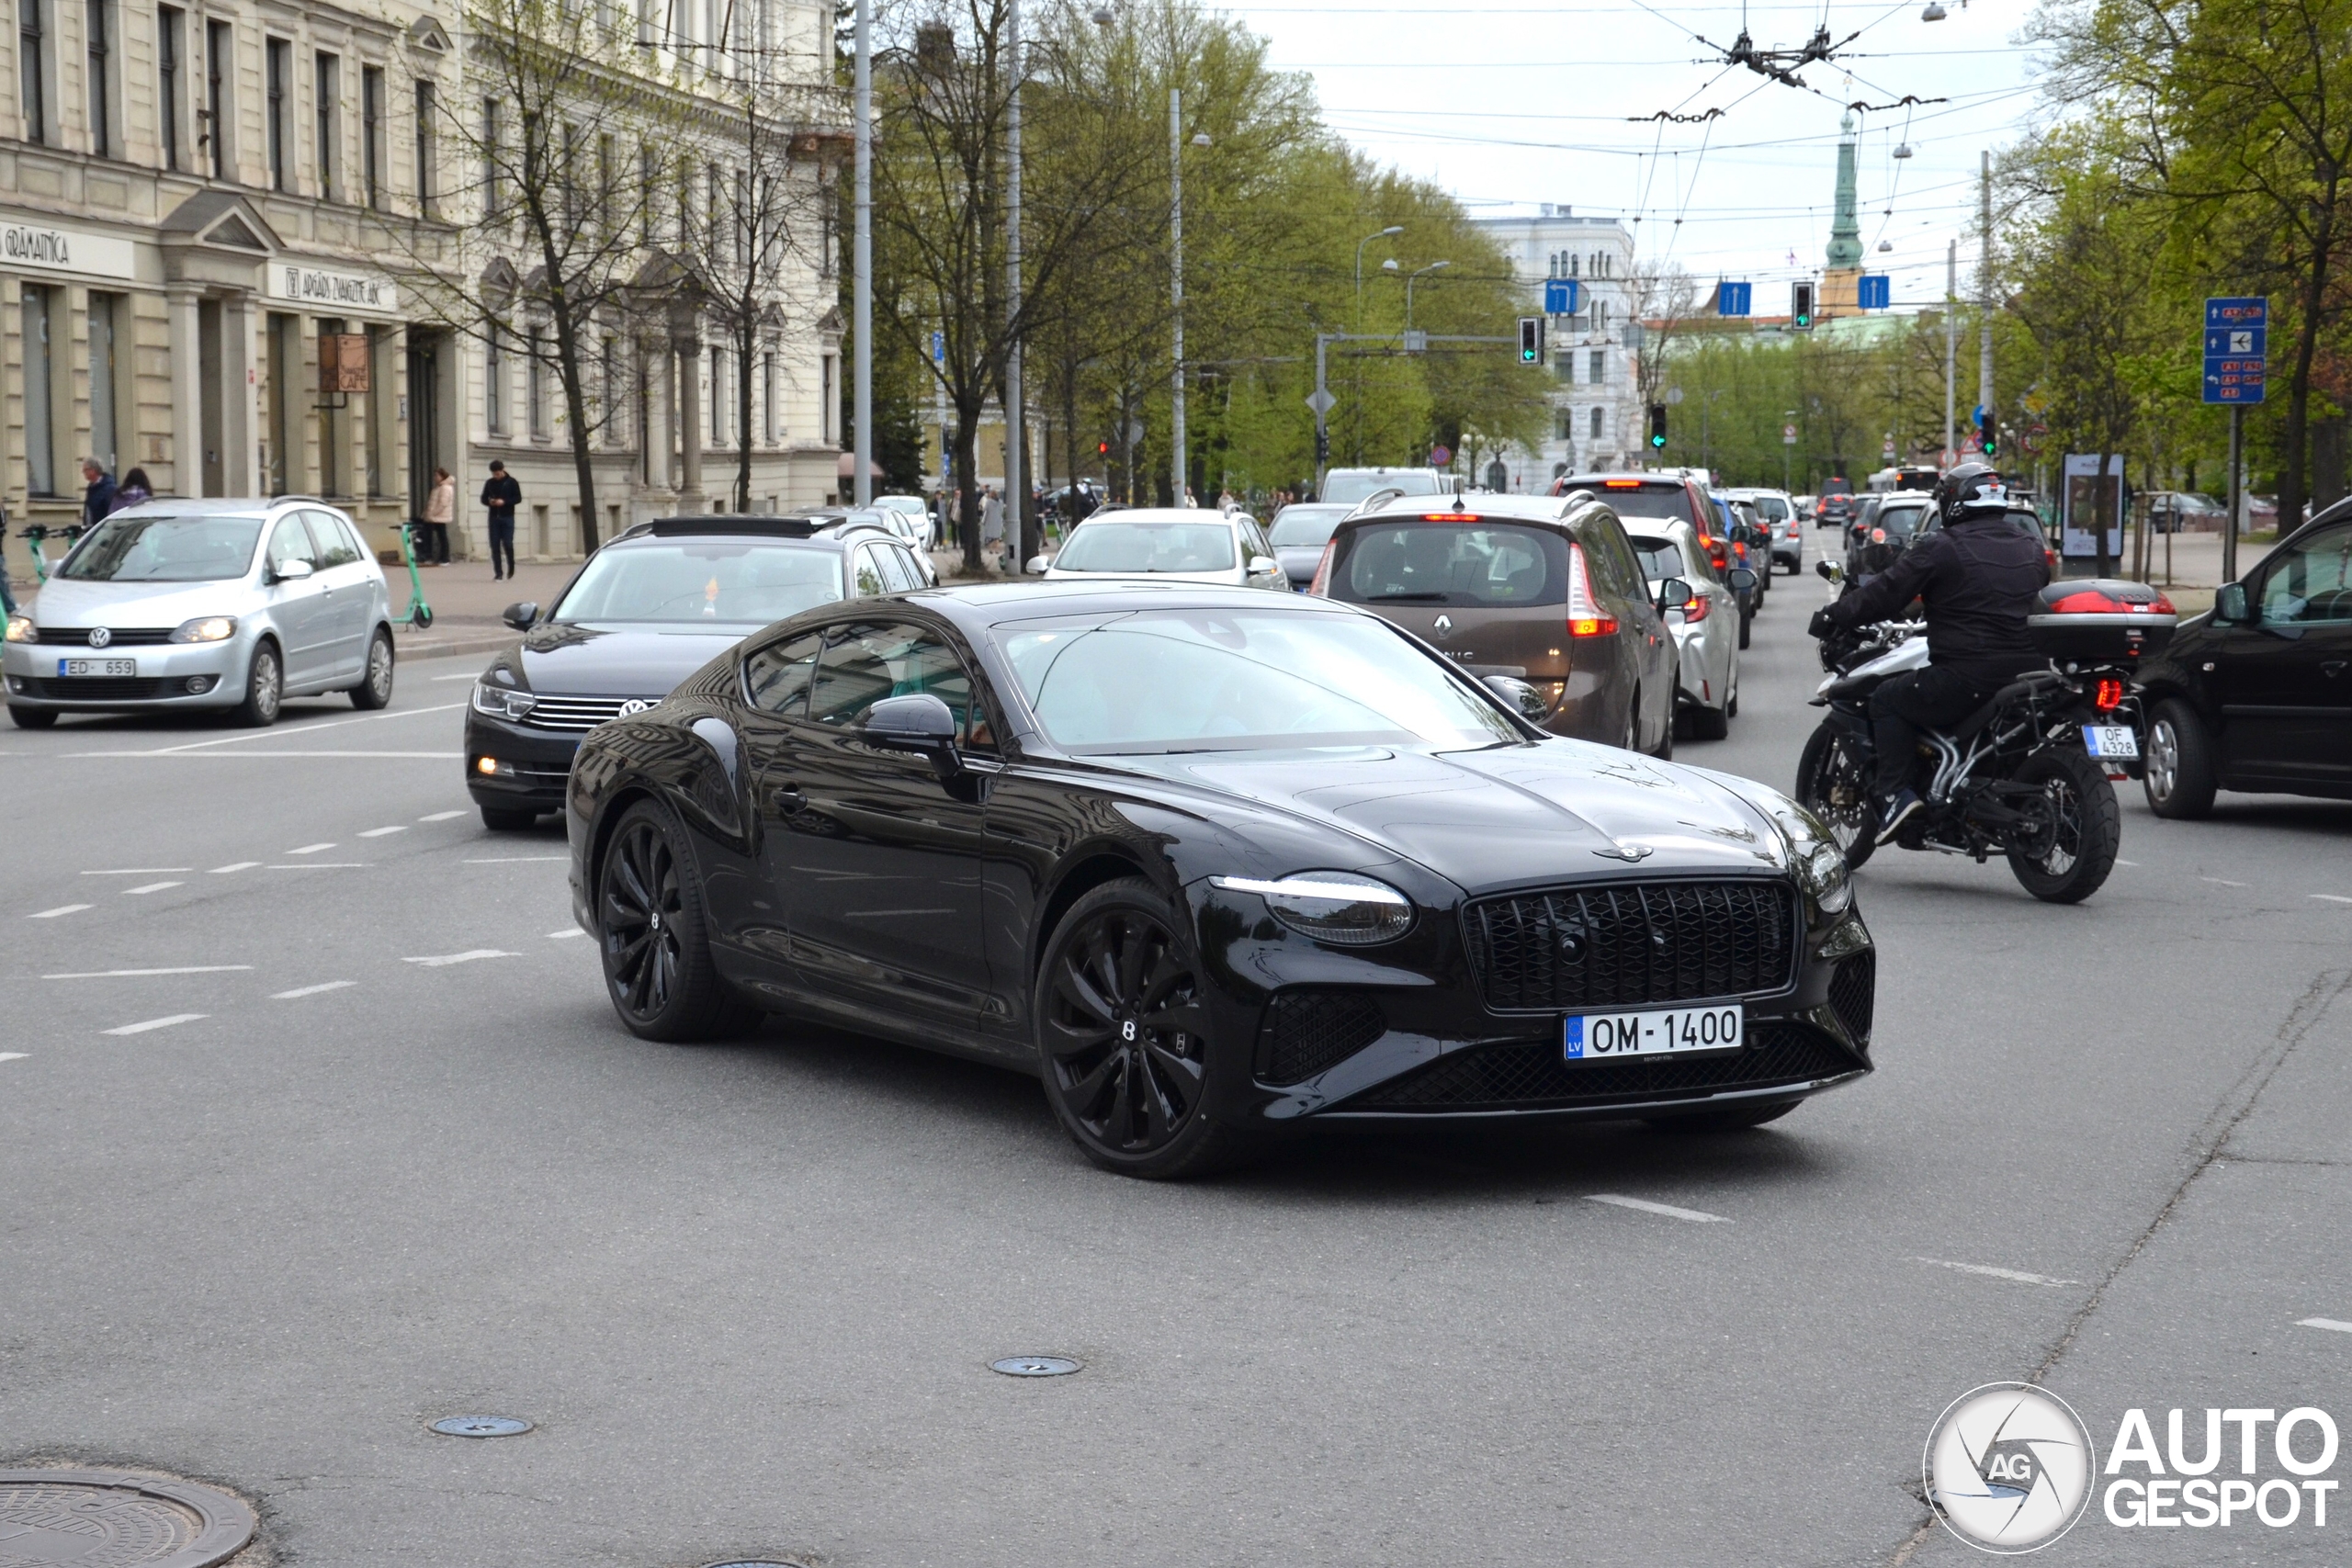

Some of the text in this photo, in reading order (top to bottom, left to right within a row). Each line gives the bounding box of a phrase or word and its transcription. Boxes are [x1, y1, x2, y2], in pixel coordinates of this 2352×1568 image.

[2105, 728, 2122, 741] OF
[2103, 741, 2133, 754] 4328
[1592, 1010, 1736, 1053] OM-1400
[1568, 1042, 1581, 1053] LV
